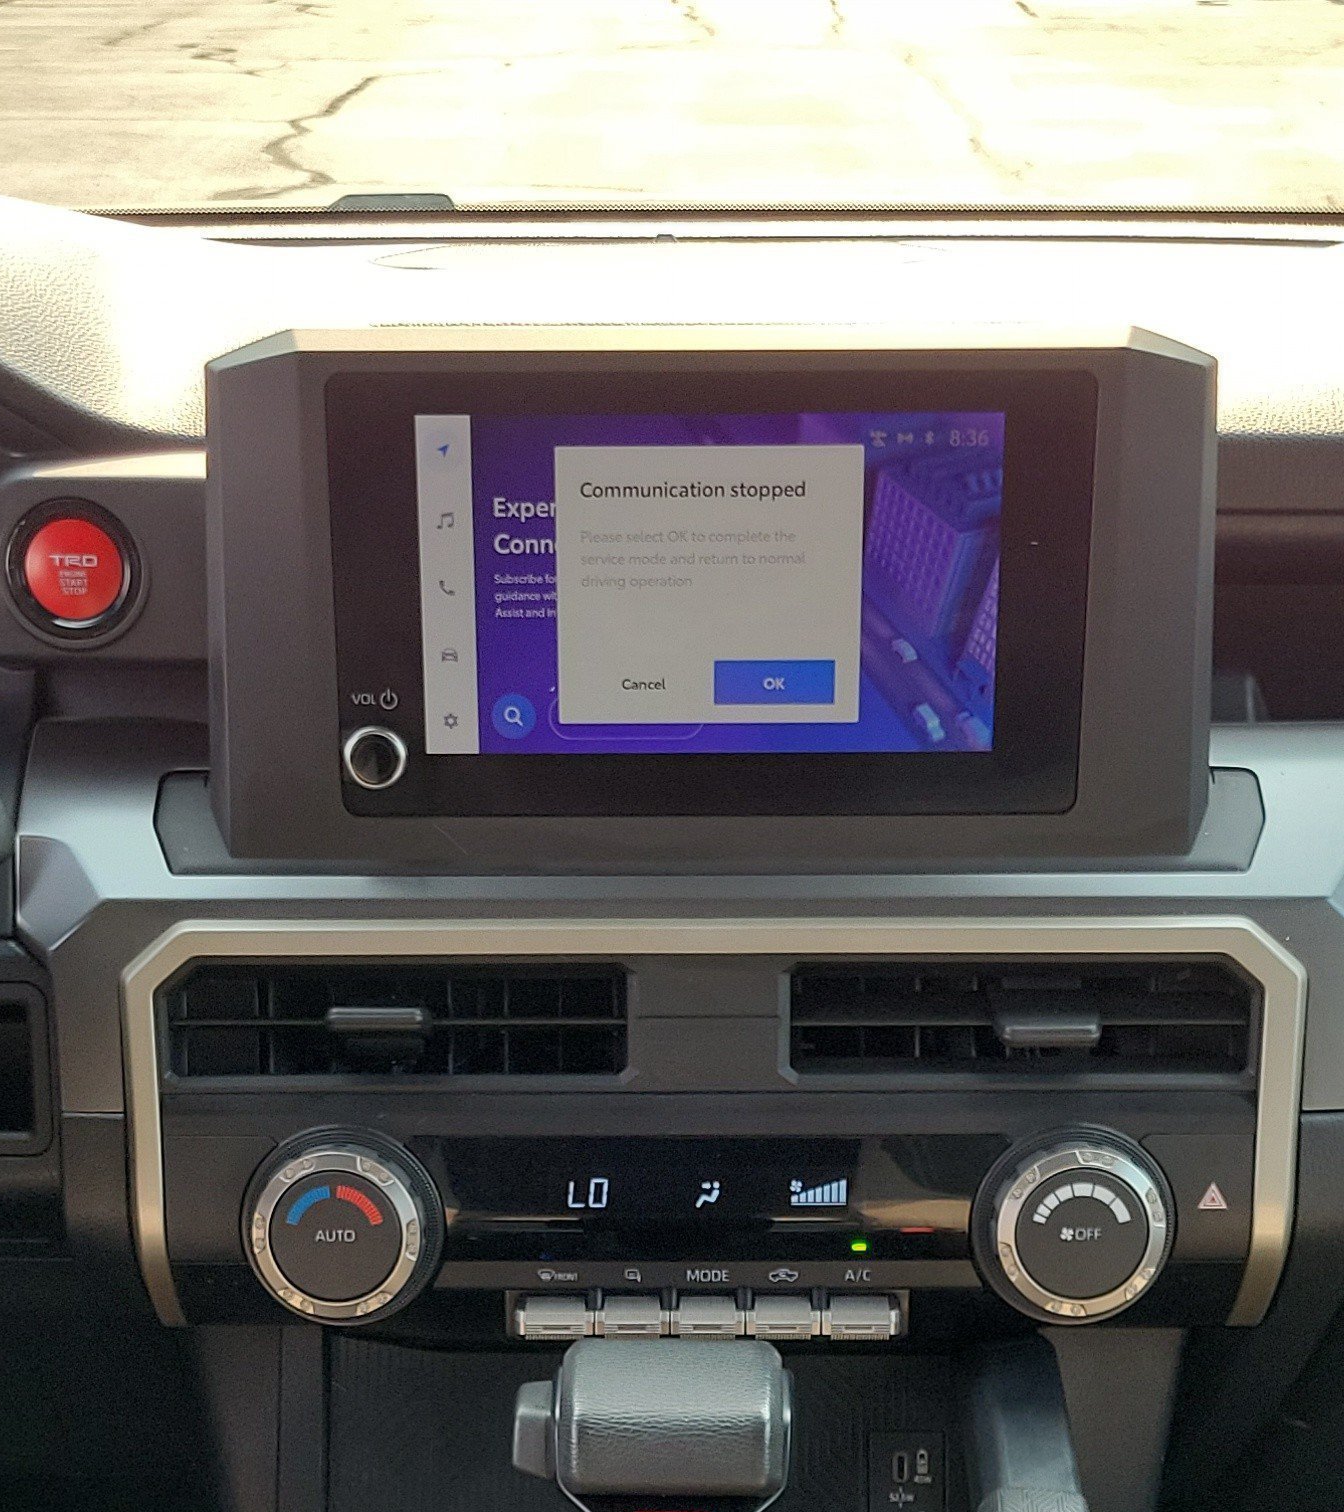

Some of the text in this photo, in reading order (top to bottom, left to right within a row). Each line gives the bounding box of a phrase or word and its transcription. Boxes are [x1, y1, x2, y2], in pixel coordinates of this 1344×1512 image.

[580, 482, 806, 501] Communication stopped
[494, 534, 556, 555] Conn
[580, 531, 796, 545] Please select OK to complete the
[49, 555, 98, 568] TRD
[580, 552, 806, 566] service mode and return to normal
[494, 574, 556, 584] Subscribe fo
[581, 577, 693, 590] driving operation
[495, 592, 541, 603] guidance
[495, 608, 524, 618] Assist
[526, 608, 545, 618] and
[621, 677, 786, 690] Cancel OK
[352, 693, 376, 705] VOL
[567, 1178, 609, 1208] LO
[316, 1229, 356, 1242] AUTO
[1075, 1228, 1102, 1241] OFF
[686, 1269, 730, 1282] MODE
[844, 1269, 871, 1282] A/C
